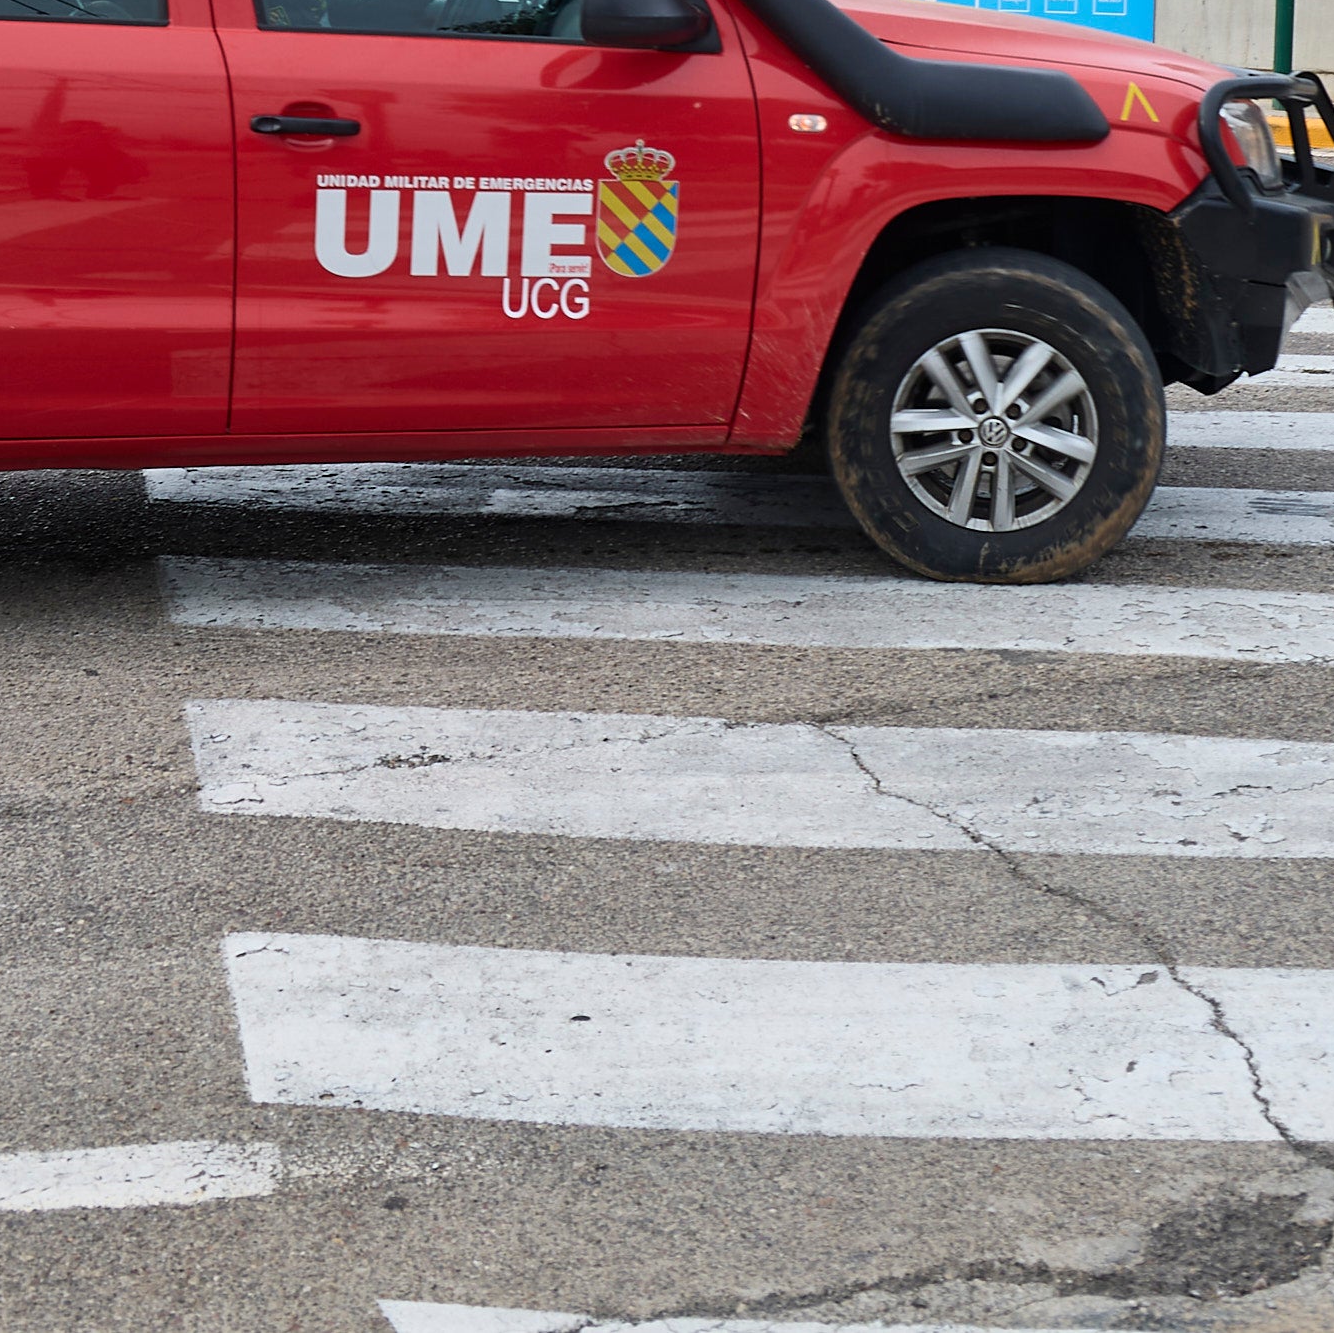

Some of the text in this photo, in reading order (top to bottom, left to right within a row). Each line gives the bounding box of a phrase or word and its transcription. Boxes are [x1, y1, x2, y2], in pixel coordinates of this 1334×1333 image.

[316, 174, 594, 192] UNIDAD MILITAR DE EMERGENCIAS
[314, 189, 594, 278] UME
[502, 277, 591, 320] UCG
